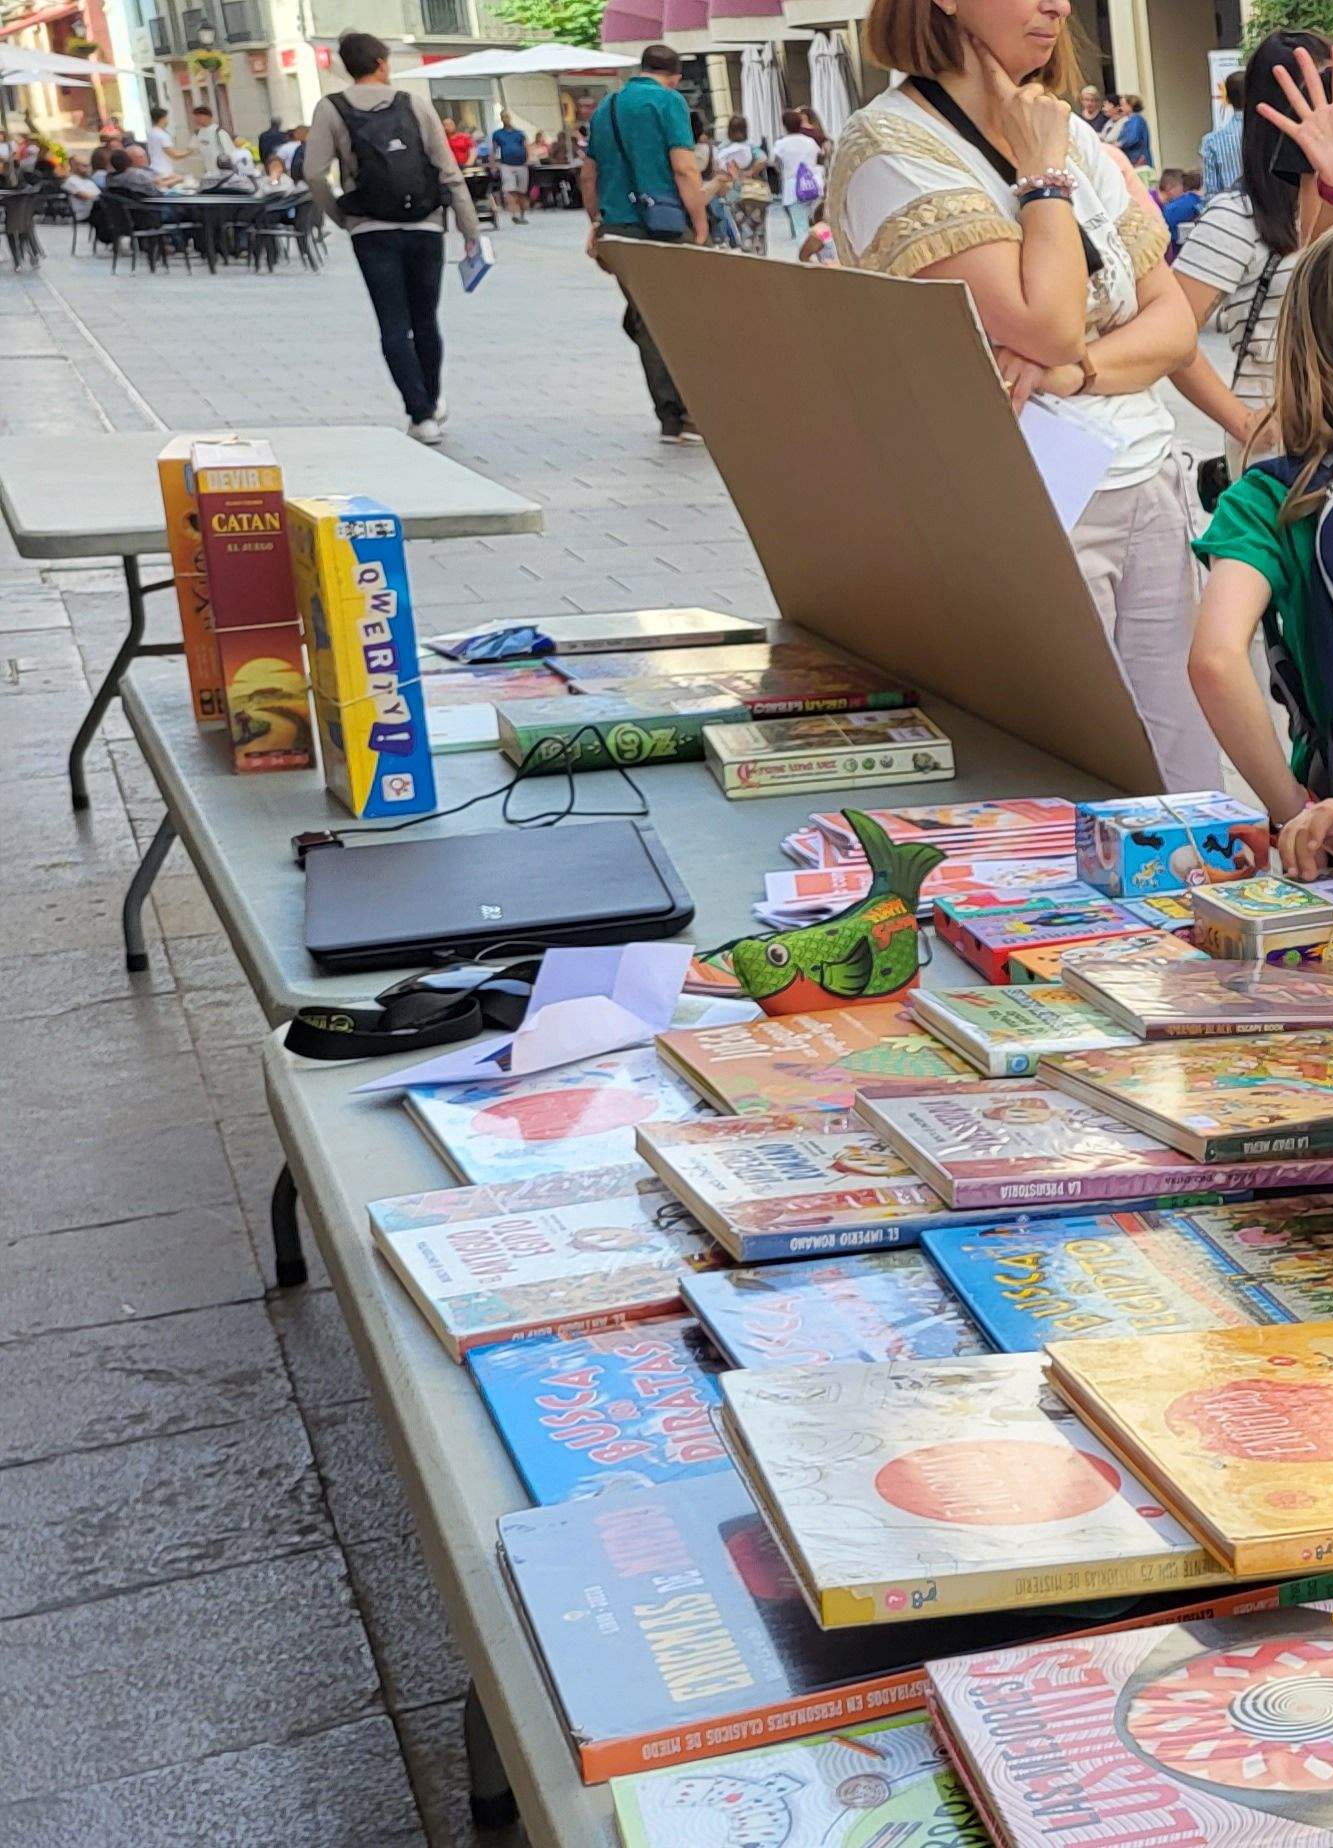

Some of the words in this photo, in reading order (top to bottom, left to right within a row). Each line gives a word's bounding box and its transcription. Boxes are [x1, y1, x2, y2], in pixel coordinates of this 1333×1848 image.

[211, 512, 281, 533] CATAN
[999, 1182, 1064, 1199] PREHISTORIA
[1067, 1181, 1081, 1196] LA
[492, 1218, 555, 1258] EGIPTO
[789, 1232, 836, 1251] ROMANO
[838, 1228, 883, 1246] IMPERIO
[884, 1226, 900, 1241] EL
[995, 1251, 1113, 1332] BUSCA
[1064, 1238, 1178, 1330] EGIPTO
[536, 1364, 658, 1465] BUSCA
[614, 1339, 728, 1463] PIRATAS
[1196, 1390, 1321, 1461] ENIGMAS
[1014, 1571, 1062, 1596] MISTERIO
[633, 1598, 756, 1704] ENIGMAS
[766, 1699, 843, 1732] PERSONAJES
[845, 1694, 863, 1711] EN
[684, 1732, 701, 1747] DE
[968, 1680, 1075, 1781] MEJORES
[641, 1737, 680, 1760] MIEDO
[1023, 1783, 1101, 1834] LAS
